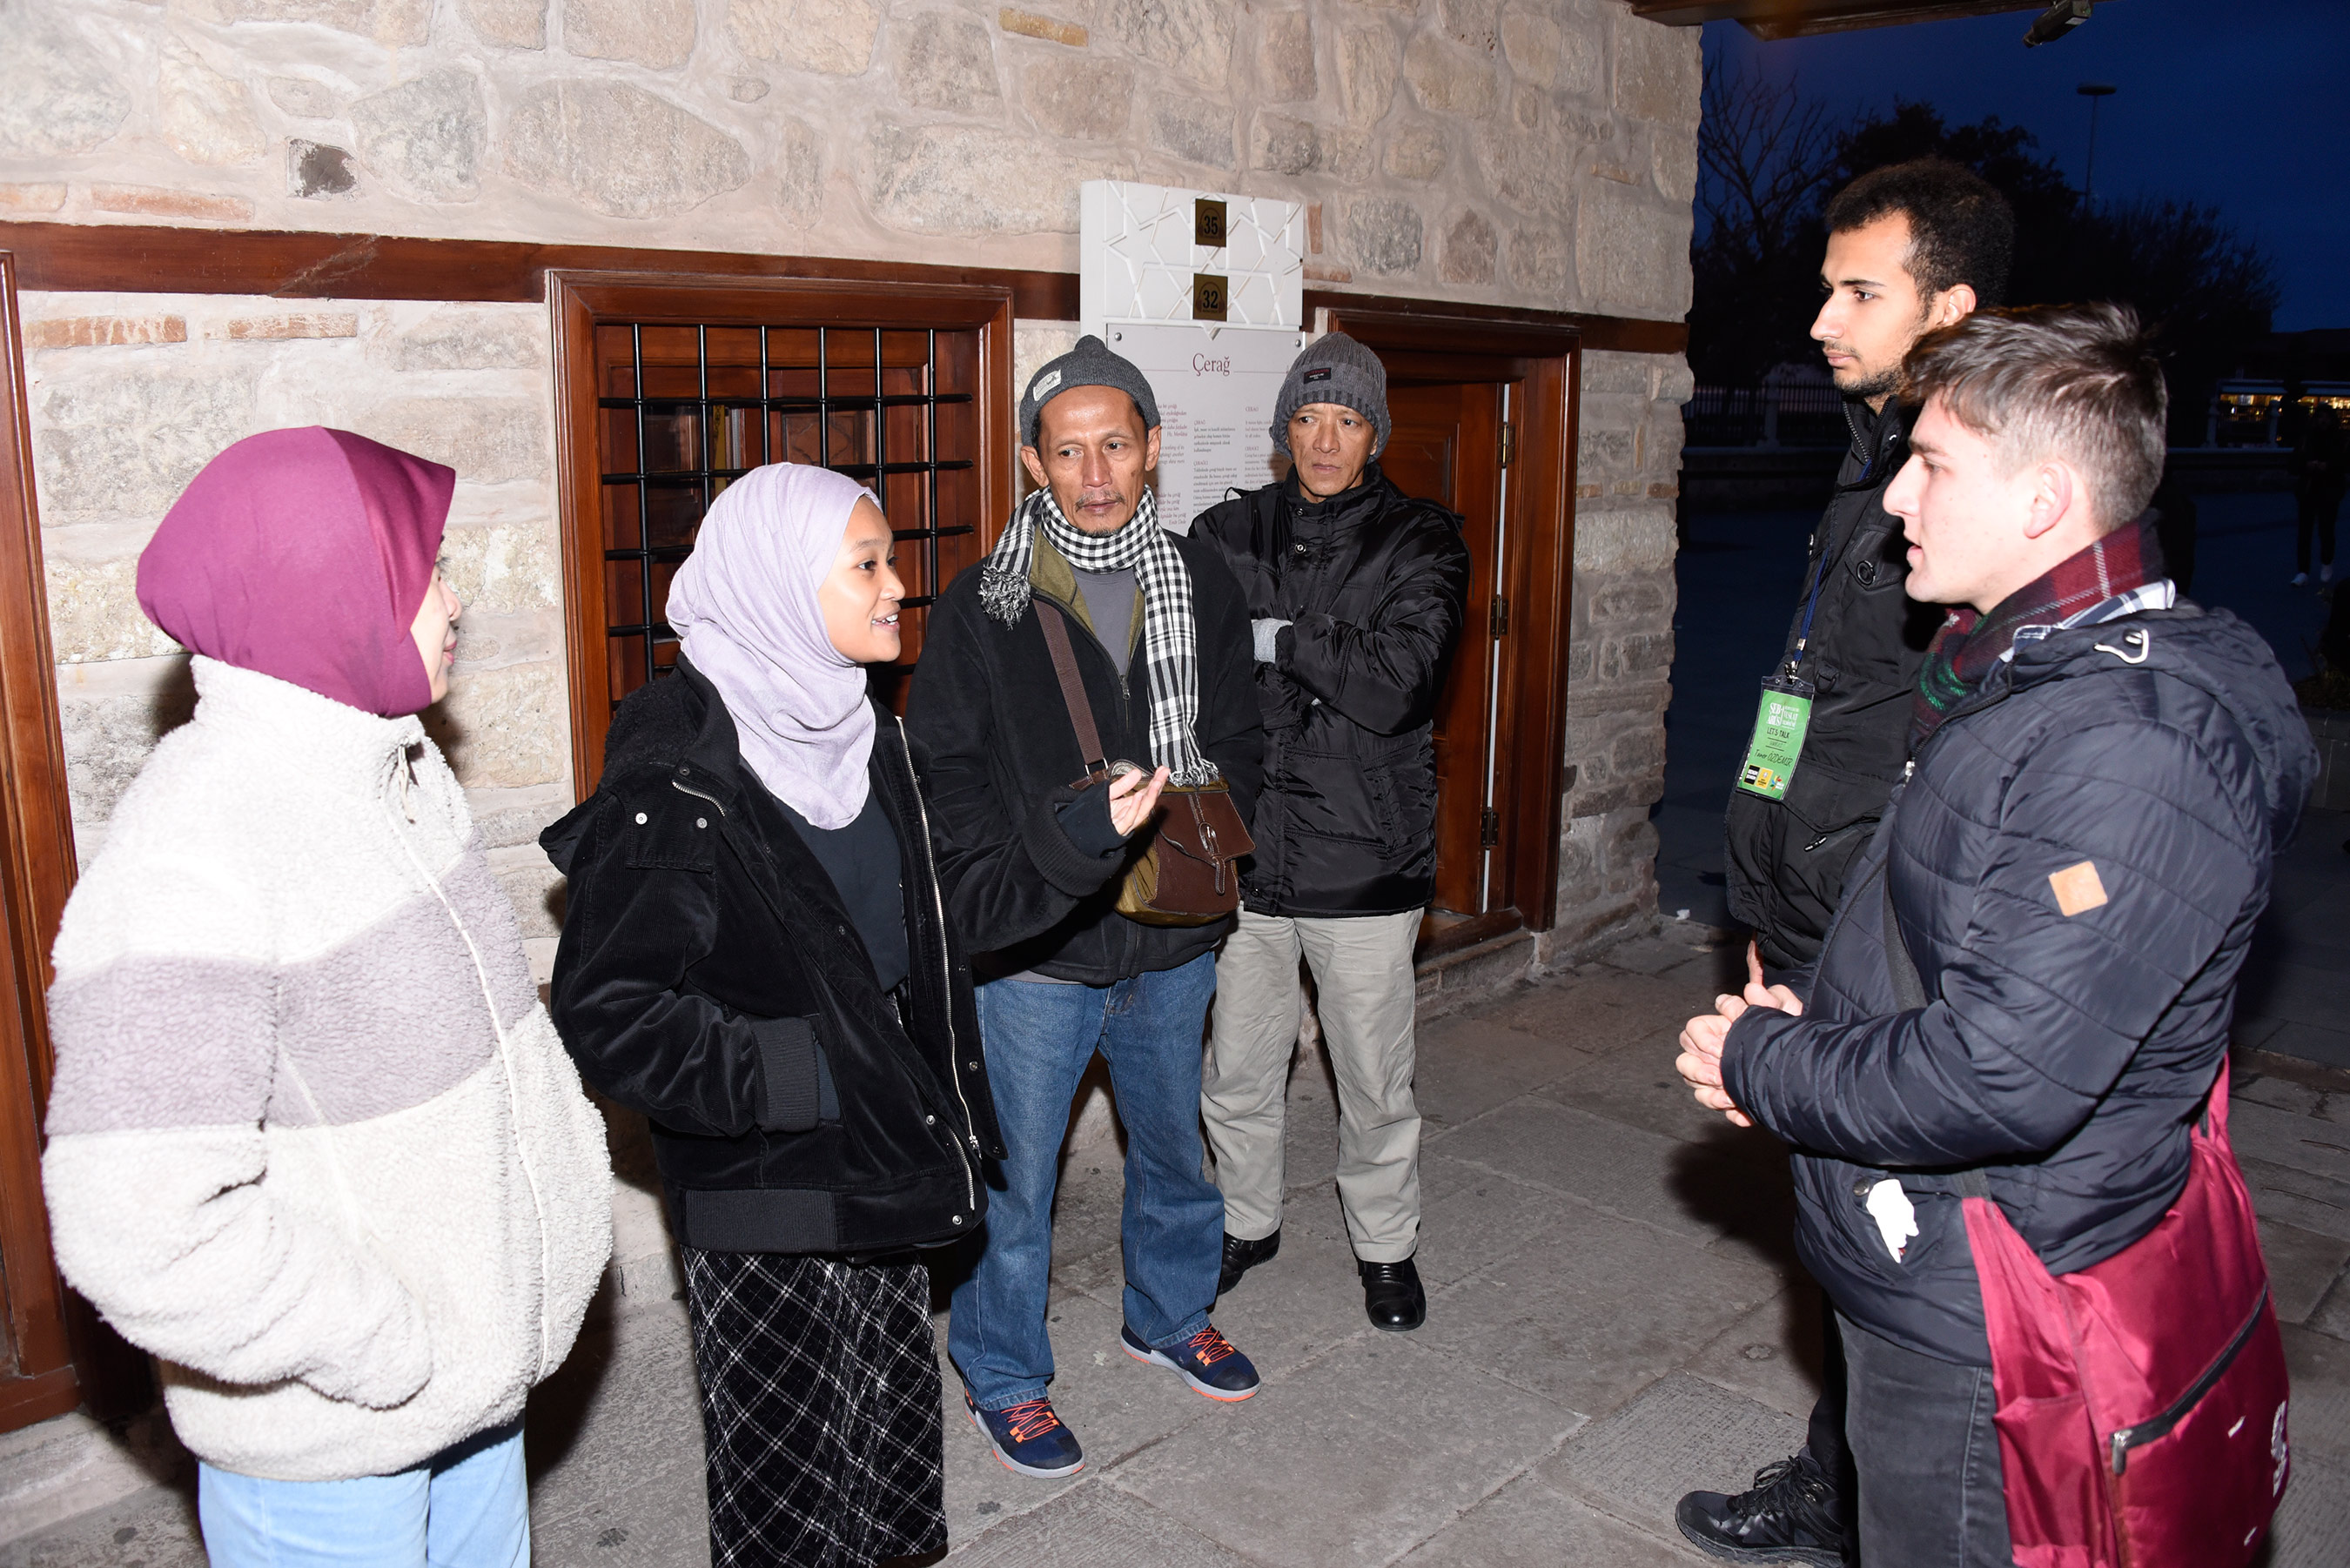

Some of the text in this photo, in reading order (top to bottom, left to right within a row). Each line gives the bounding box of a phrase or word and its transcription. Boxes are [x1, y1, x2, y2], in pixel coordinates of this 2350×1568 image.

[1204, 215, 1219, 235] 35
[1203, 290, 1219, 309] 32
[1192, 352, 1231, 377] Çerağ
